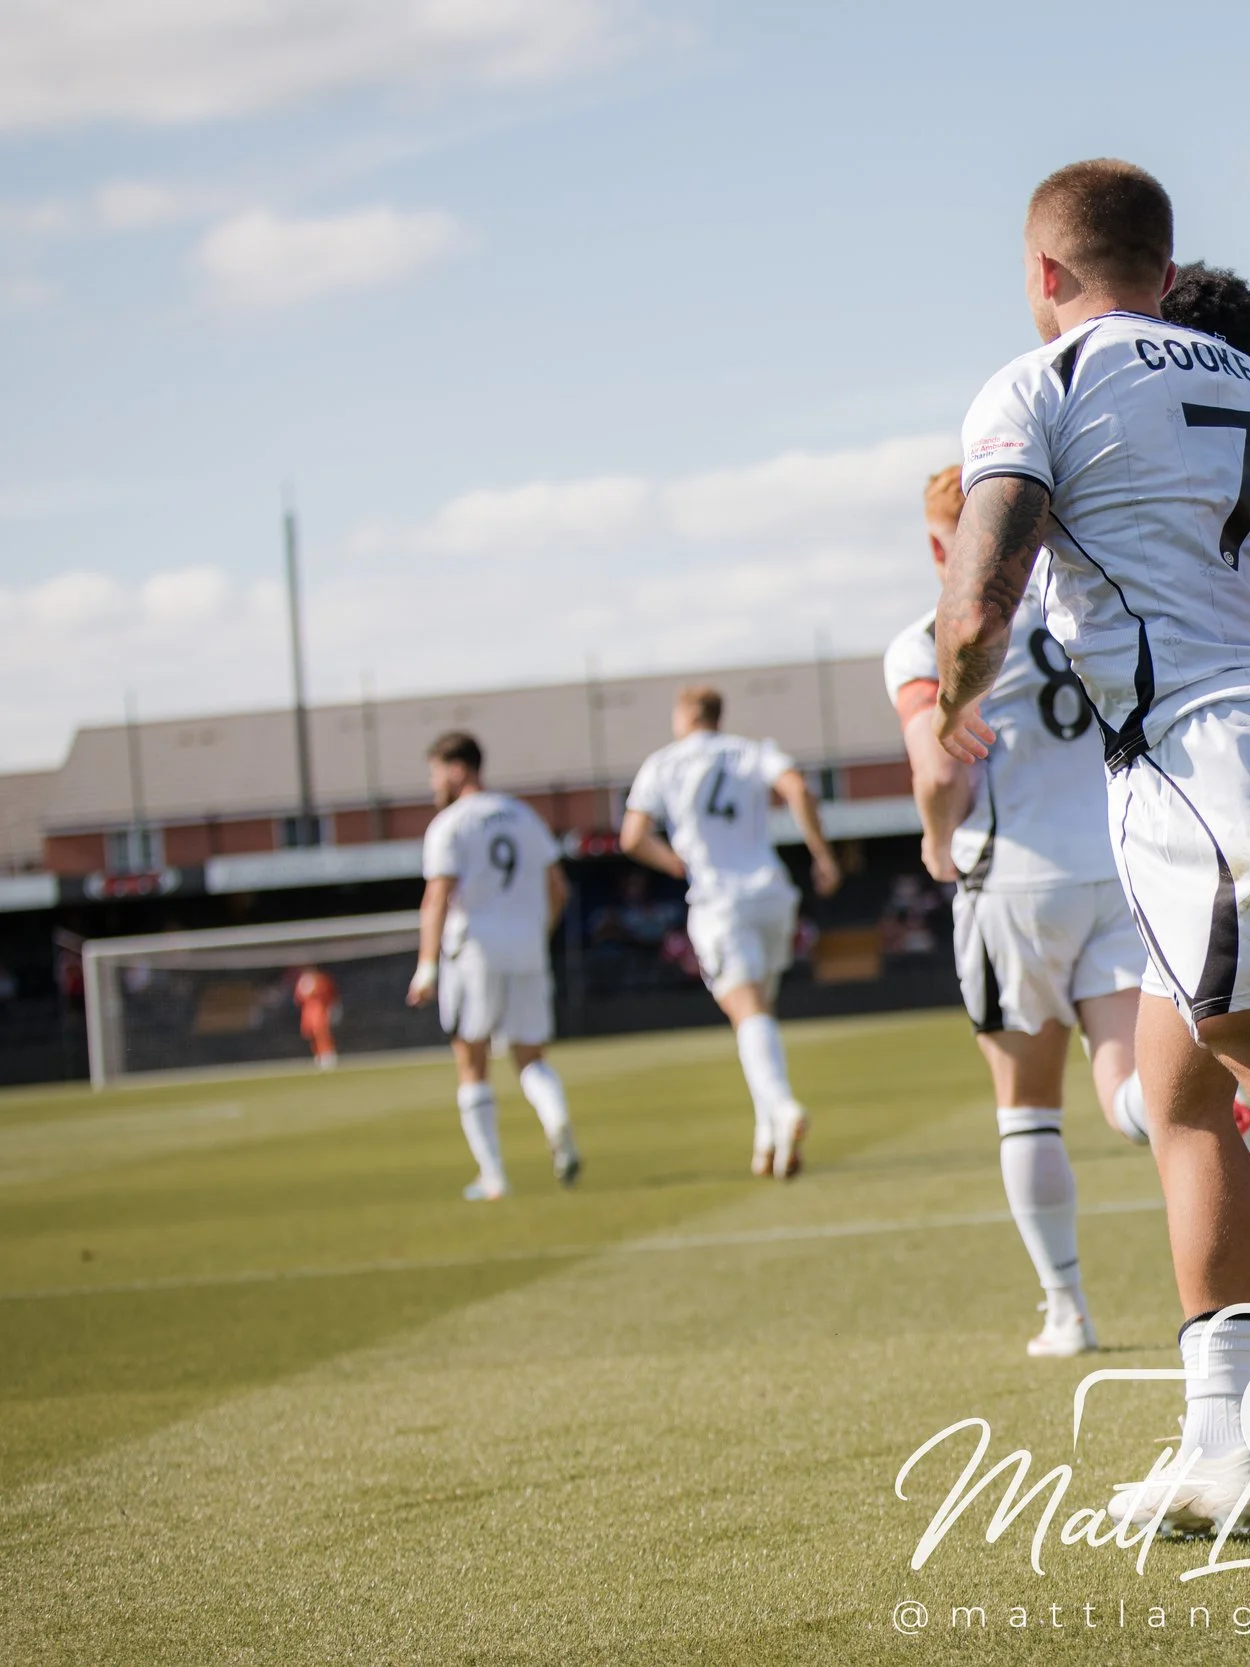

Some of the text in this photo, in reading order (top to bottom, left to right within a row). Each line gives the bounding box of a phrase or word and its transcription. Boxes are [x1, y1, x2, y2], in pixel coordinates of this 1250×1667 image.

[1029, 628, 1092, 741] 8
[706, 769, 736, 824] 4
[489, 834, 516, 893] 9
